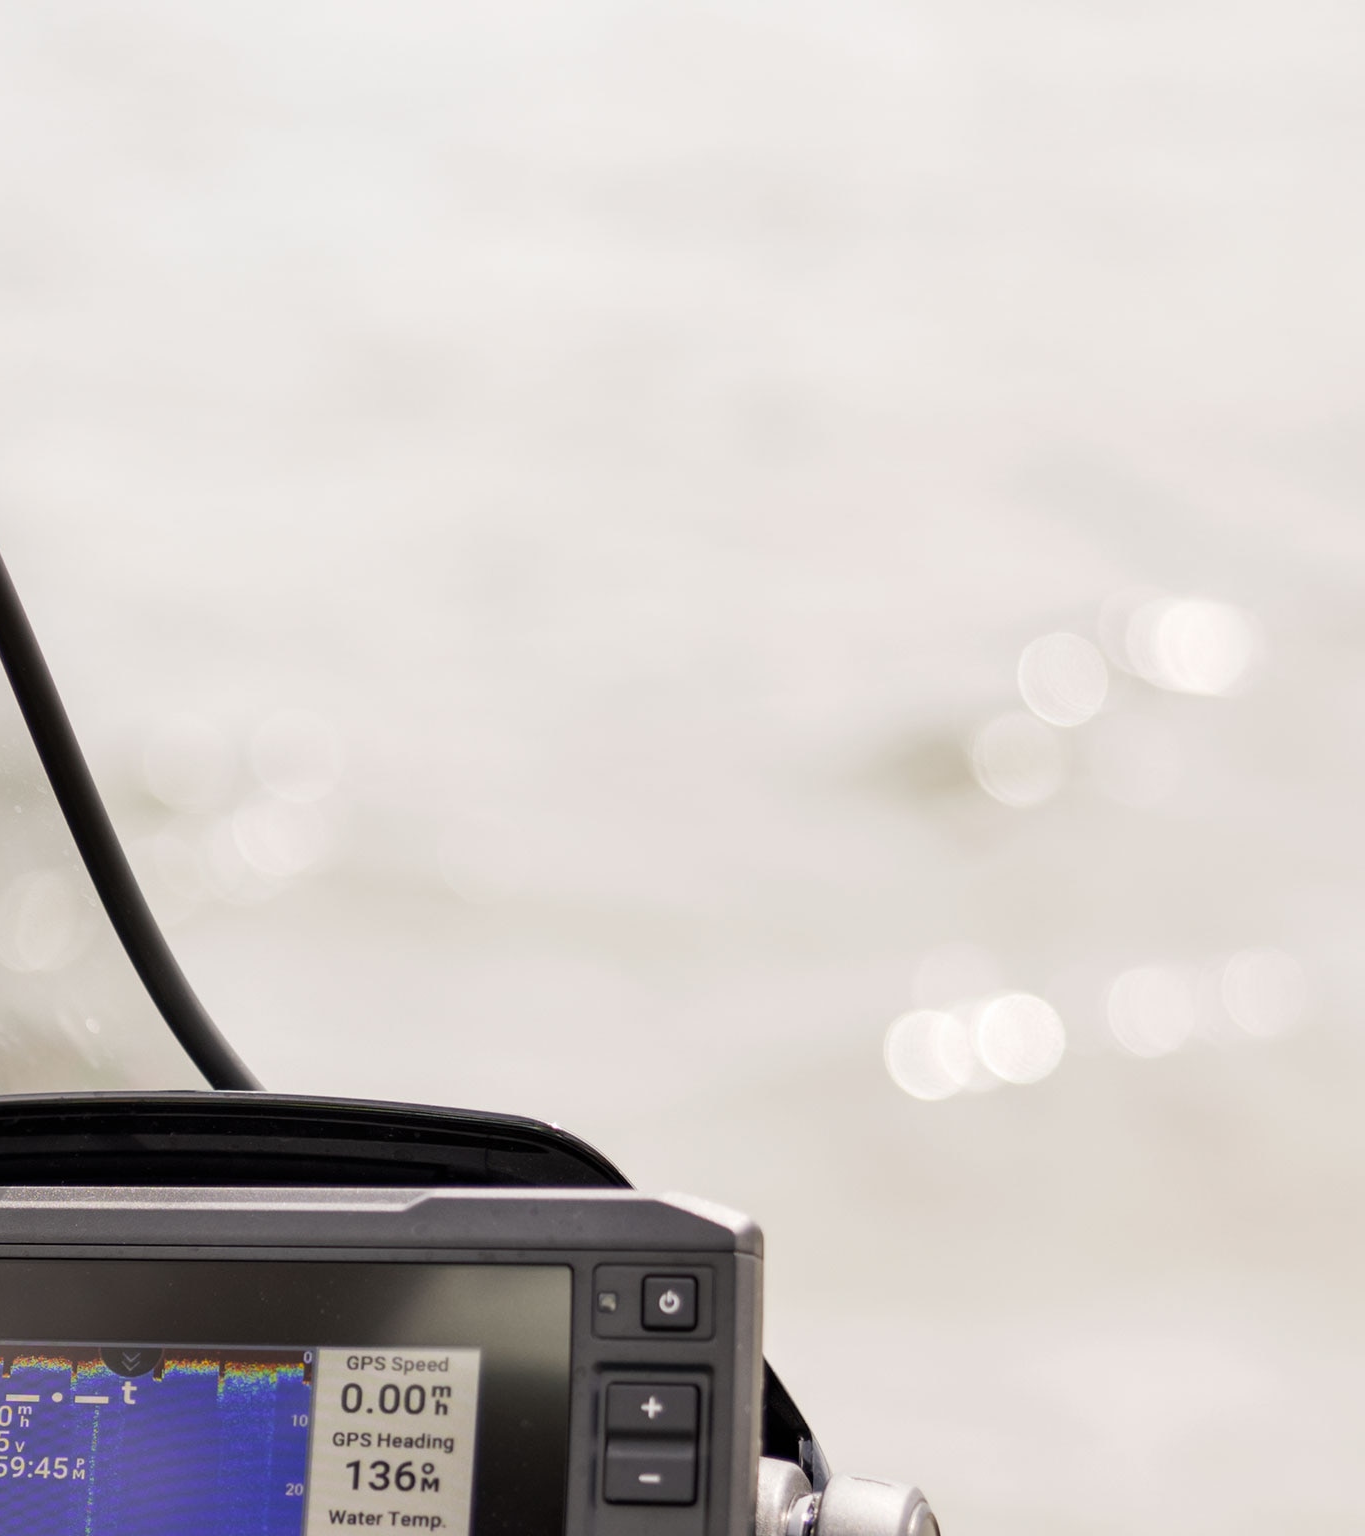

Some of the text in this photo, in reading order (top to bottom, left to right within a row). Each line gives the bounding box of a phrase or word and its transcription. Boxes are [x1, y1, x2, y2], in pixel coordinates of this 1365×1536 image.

[303, 1351, 312, 1364] 0
[346, 1355, 449, 1375] GPS Speed
[340, 1383, 426, 1415] 0.00
[291, 1414, 308, 1427] 10
[332, 1432, 455, 1454] GPS Heading
[346, 1460, 416, 1491] 136
[285, 1483, 304, 1496] 20
[329, 1509, 447, 1531] Water Temp.
